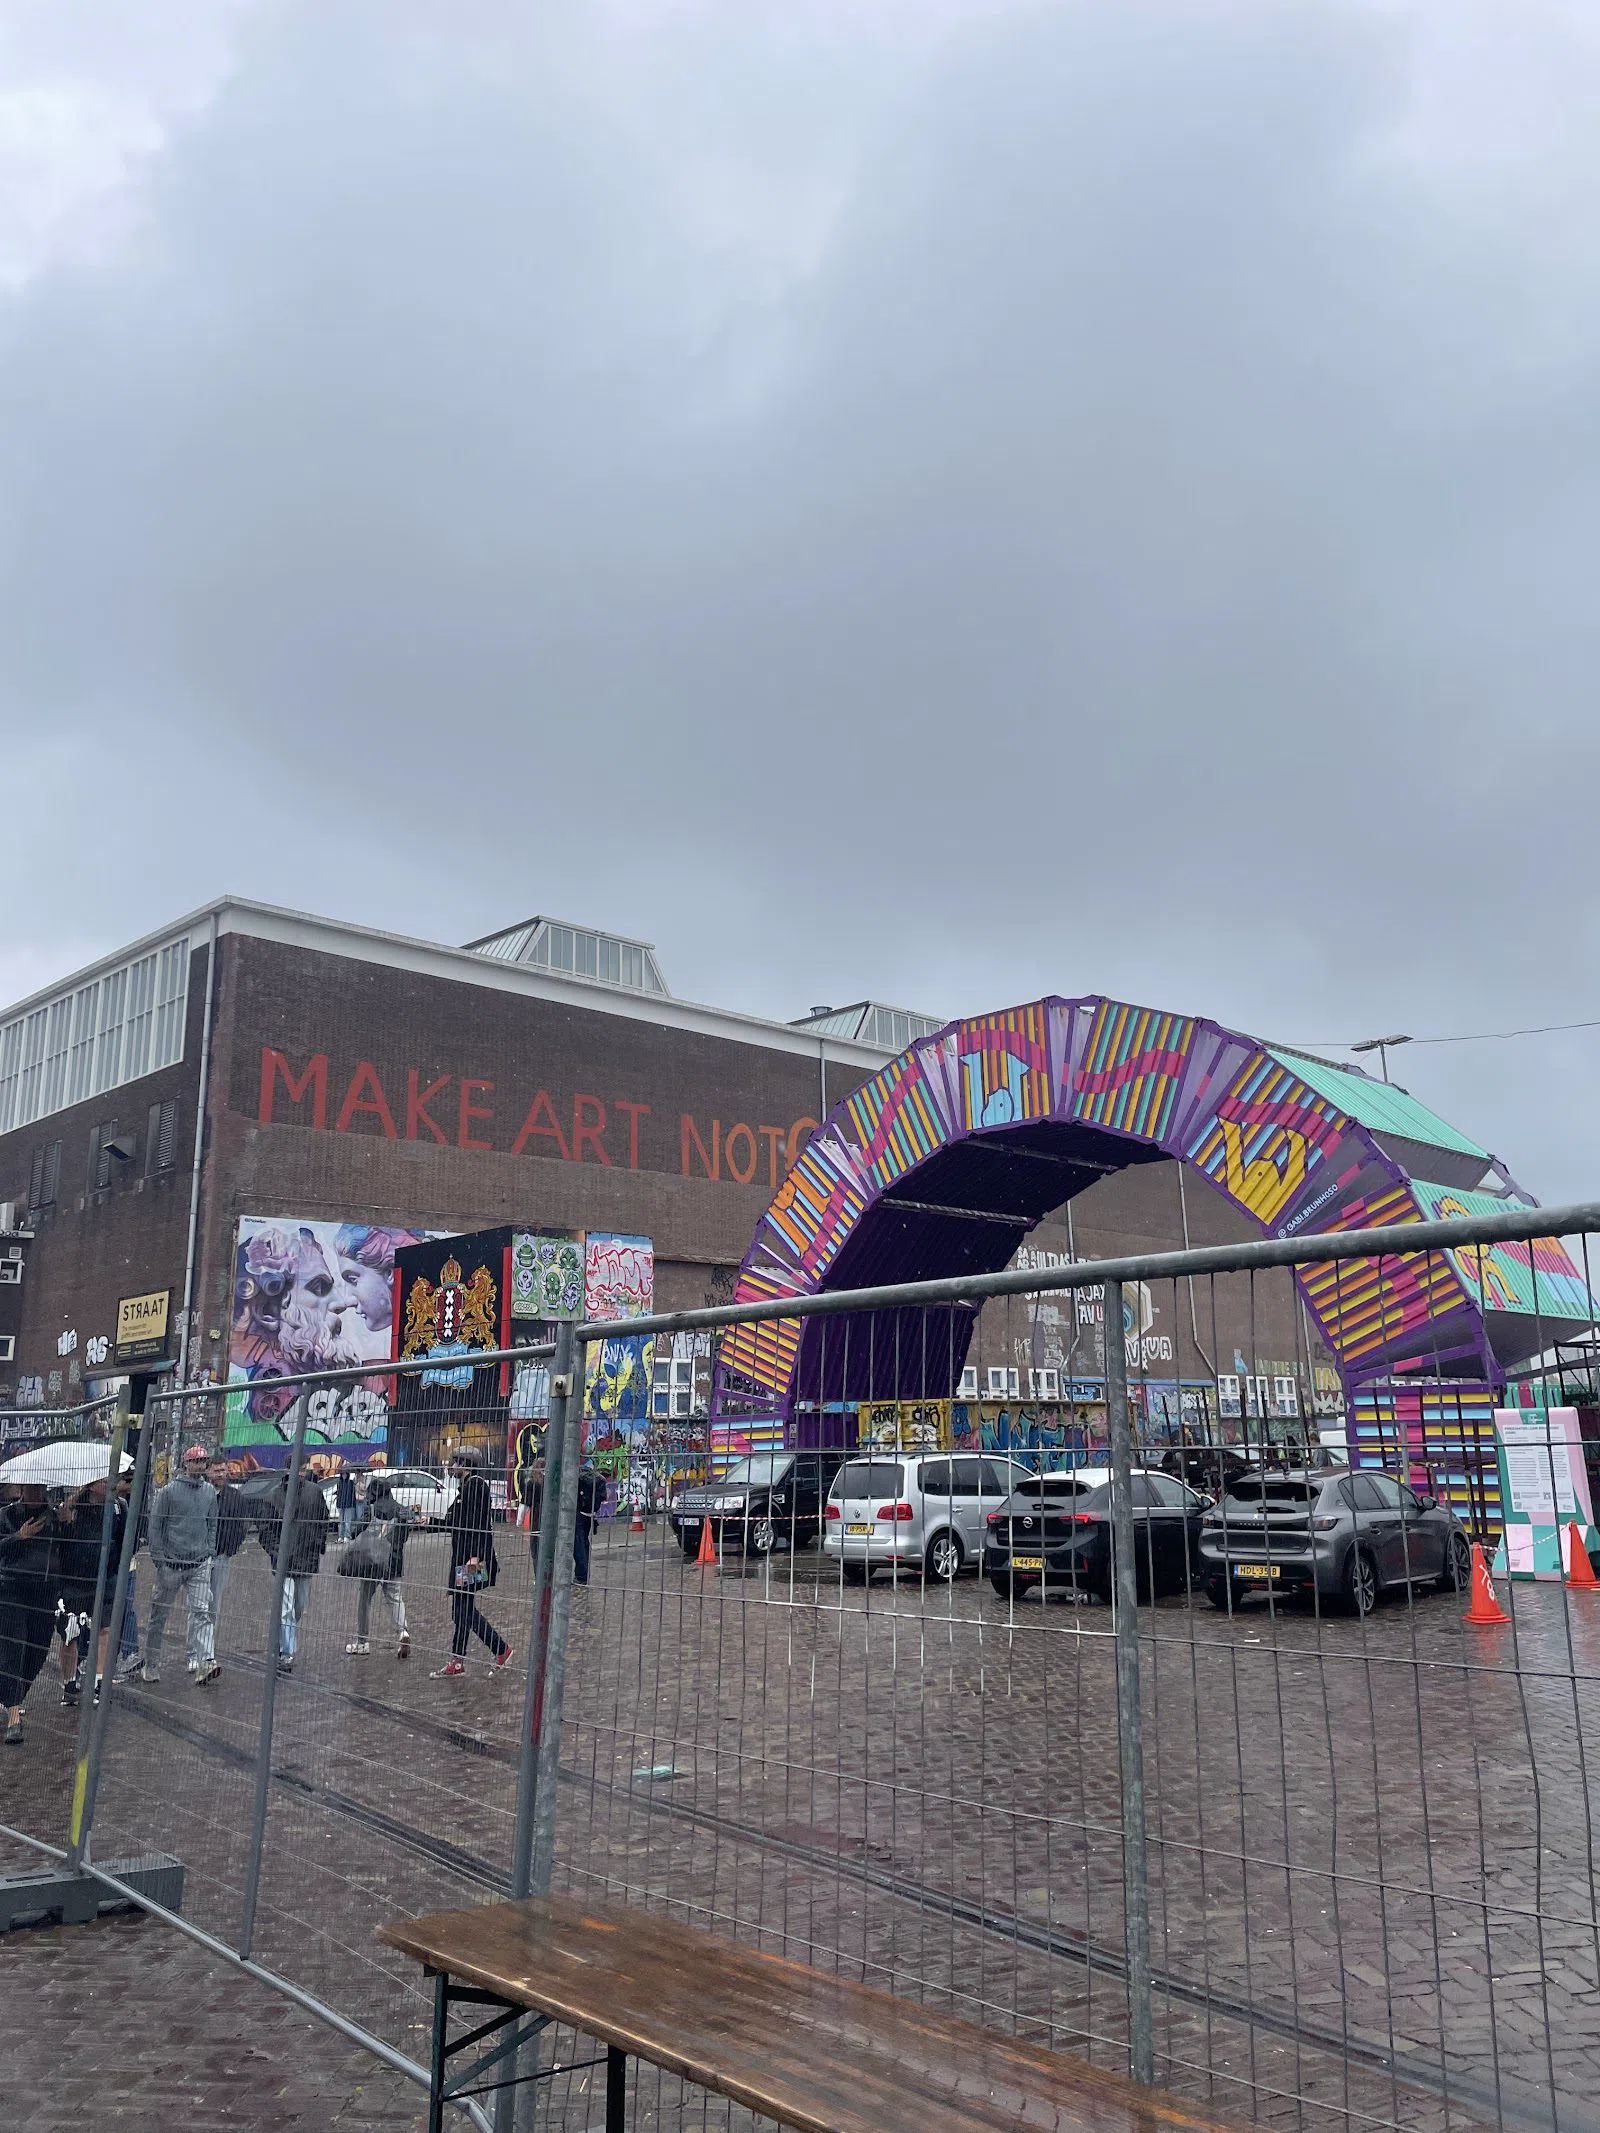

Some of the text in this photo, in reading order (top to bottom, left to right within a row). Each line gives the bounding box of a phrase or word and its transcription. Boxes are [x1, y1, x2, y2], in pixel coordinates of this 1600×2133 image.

[258, 1046, 494, 1151] MAKE
[511, 1089, 652, 1169] ART
[1286, 1183, 1338, 1232] GABI.BRUNHOSO
[1239, 1565, 1278, 1576] HDL-35B
